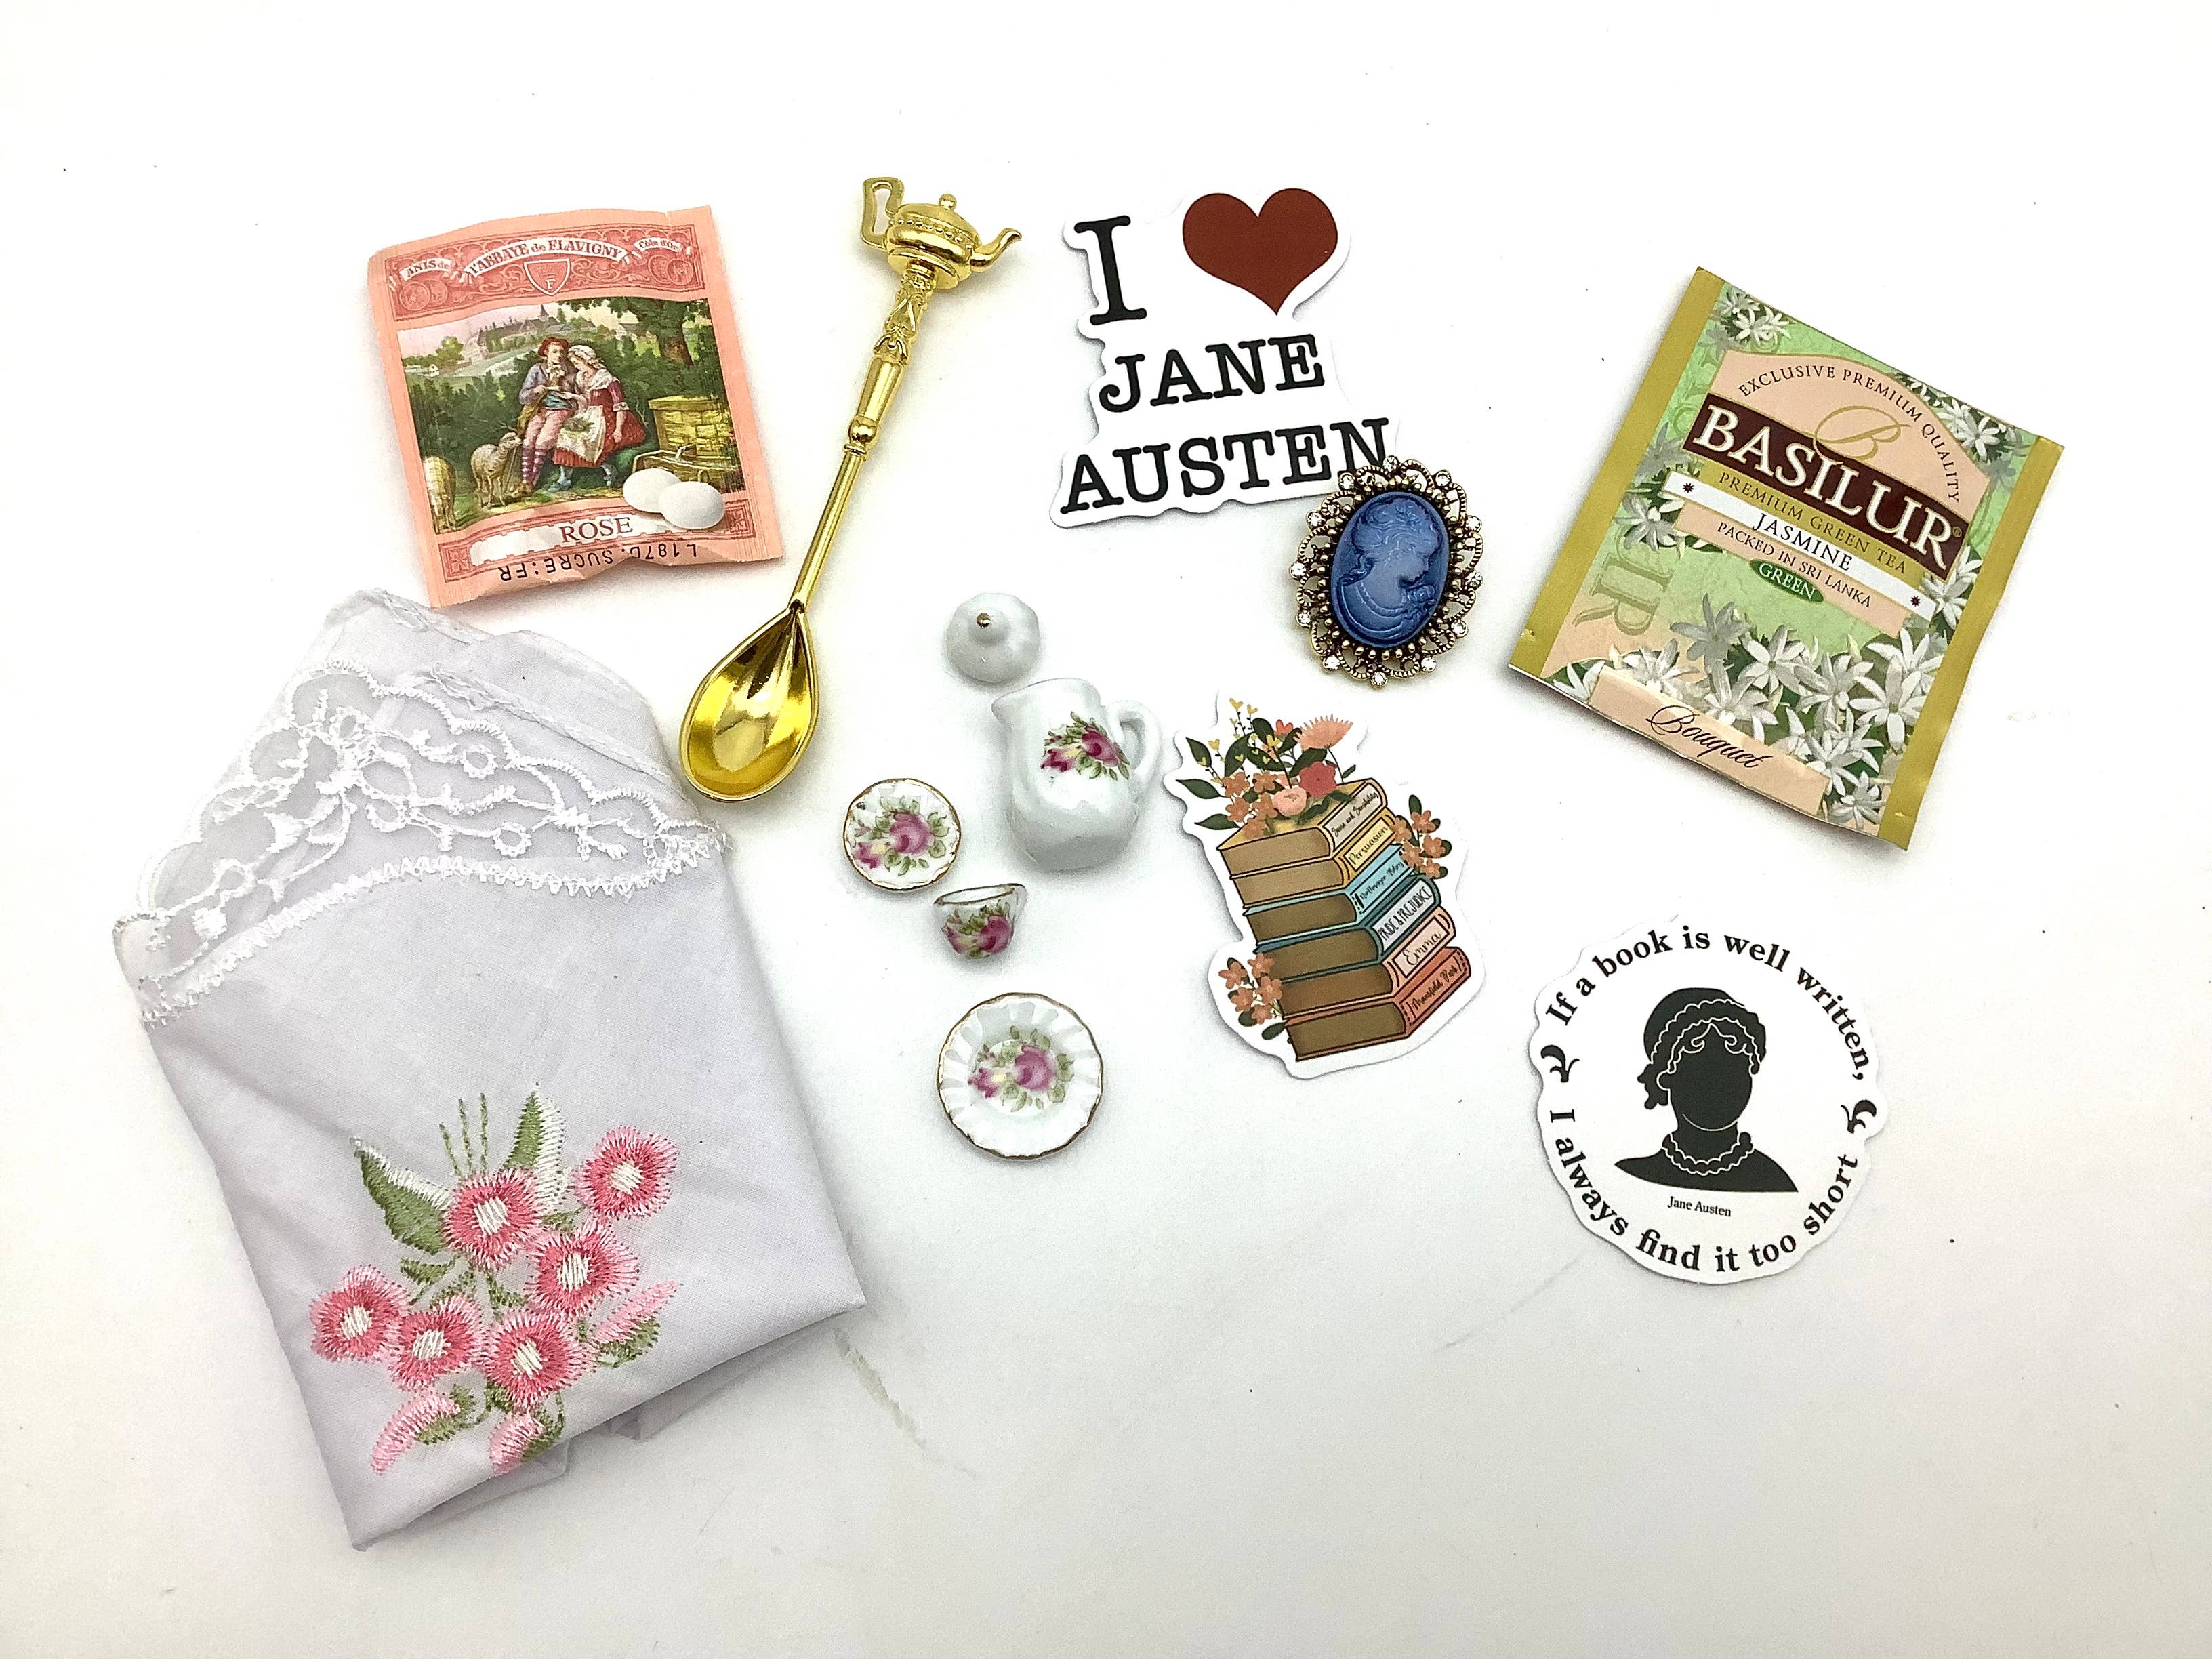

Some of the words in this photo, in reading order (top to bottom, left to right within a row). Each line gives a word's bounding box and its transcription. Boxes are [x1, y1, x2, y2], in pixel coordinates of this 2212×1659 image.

[407, 260, 436, 276] ANIS
[531, 243, 546, 252] de
[548, 239, 622, 258] FLAVIGNY
[1074, 216, 1147, 325] I
[1099, 335, 1325, 412] JANE
[1738, 365, 1835, 397] EXCLUSIVE
[1843, 368, 1923, 422] PREMIUM
[1921, 423, 1960, 502] QUALITY
[1061, 418, 1389, 513] AUSTEN
[559, 516, 633, 543] ROSE
[1720, 472, 1804, 521] PREMIUM
[1810, 516, 1871, 553] GREEN
[1878, 548, 1906, 574] TEA
[1753, 513, 1853, 571] JASMINE
[1717, 522, 1774, 556] PACKED
[1778, 551, 1797, 566] IN
[1799, 560, 1820, 580] SRI
[1825, 575, 1872, 608] LANKA
[1759, 564, 1816, 600] GREEN
[1645, 705, 1773, 768] Bouquet
[1403, 933, 1441, 965] Emma
[1546, 991, 1578, 1025] If
[1576, 978, 1595, 996] a
[1592, 930, 1673, 977] book
[1683, 925, 1710, 949] is
[1724, 935, 1790, 972] well
[1797, 967, 1869, 1080] written,
[1550, 1109, 1575, 1122] I
[1555, 1138, 1629, 1235] always
[1667, 1196, 1692, 1210] Jane
[1694, 1201, 1731, 1216] Austen
[1804, 1154, 1858, 1235] short
[1636, 1229, 1700, 1271] find
[1715, 1246, 1740, 1272] it
[1748, 1235, 1796, 1267] too
